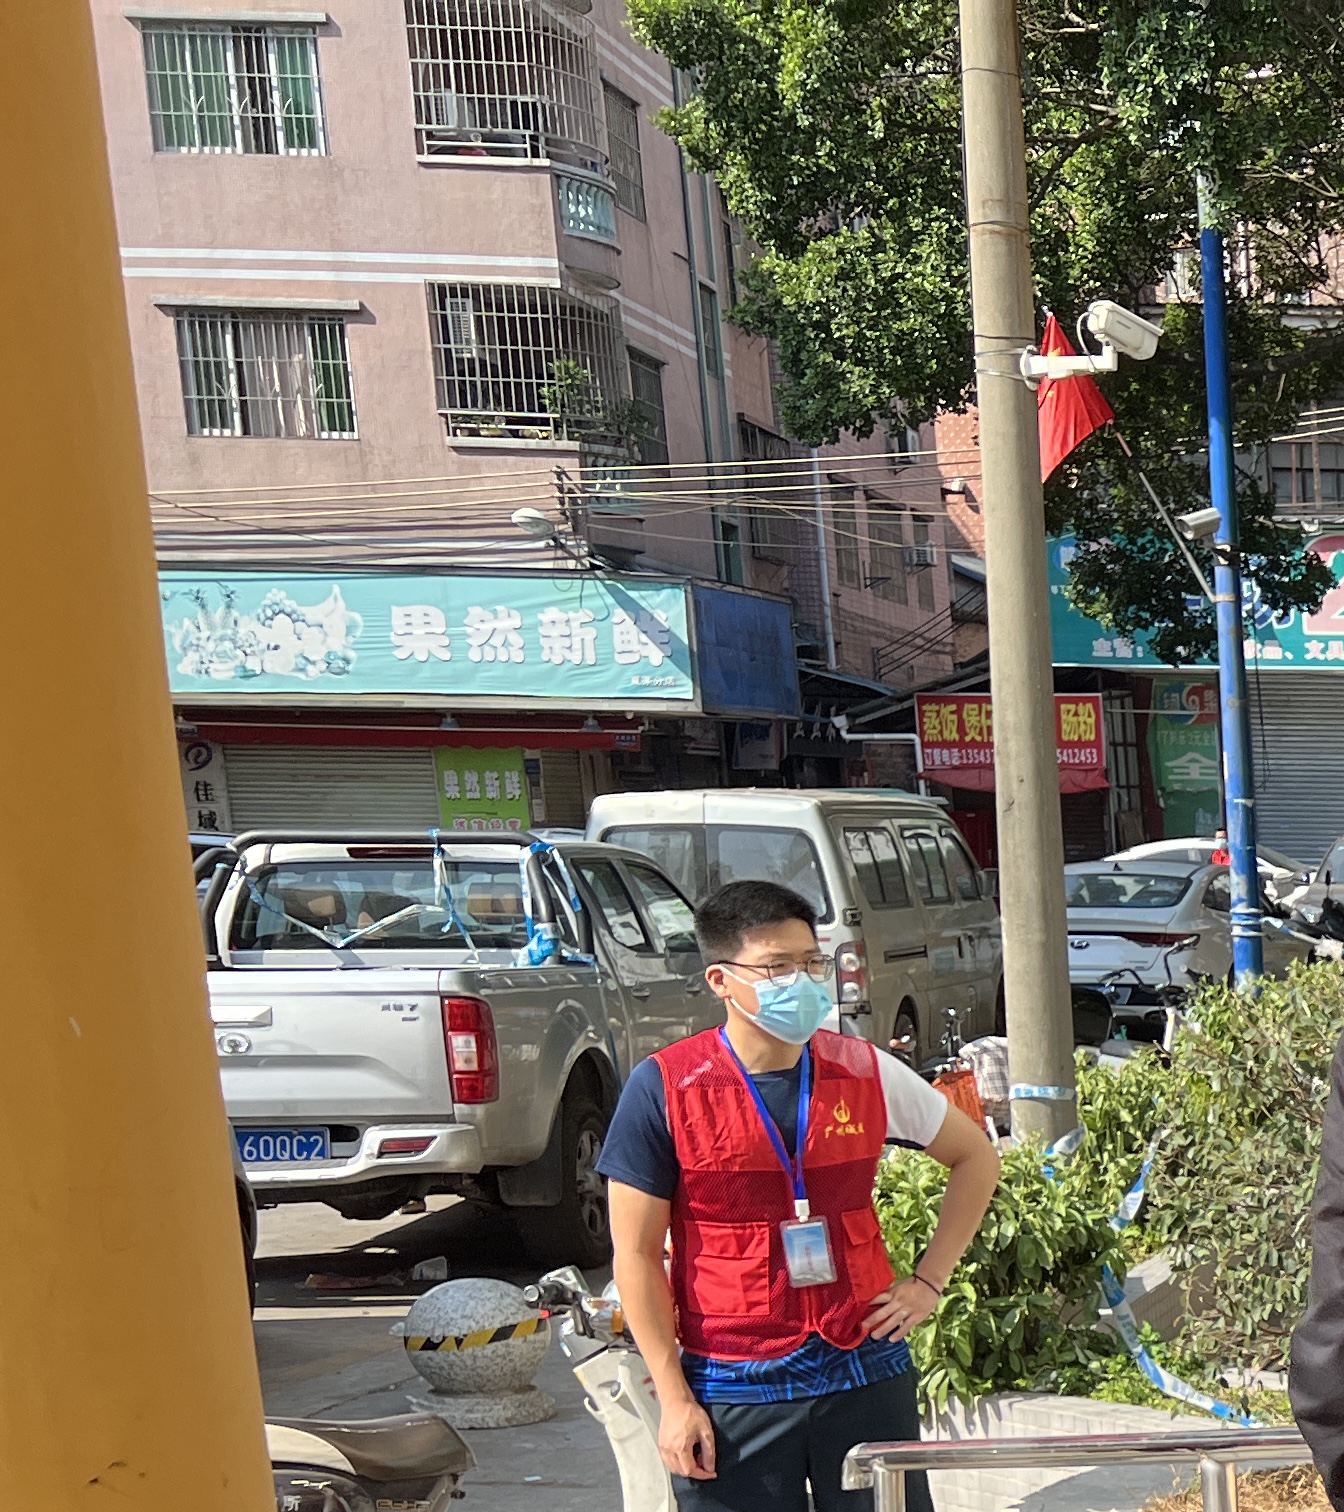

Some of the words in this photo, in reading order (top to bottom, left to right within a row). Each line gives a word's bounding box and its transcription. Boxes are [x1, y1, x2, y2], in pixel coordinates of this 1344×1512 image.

[390, 604, 672, 668] 果然新鲜
[922, 703, 959, 742] 蒸饭
[1060, 702, 1096, 742] 肠粉
[444, 770, 521, 800] 果然新鲜
